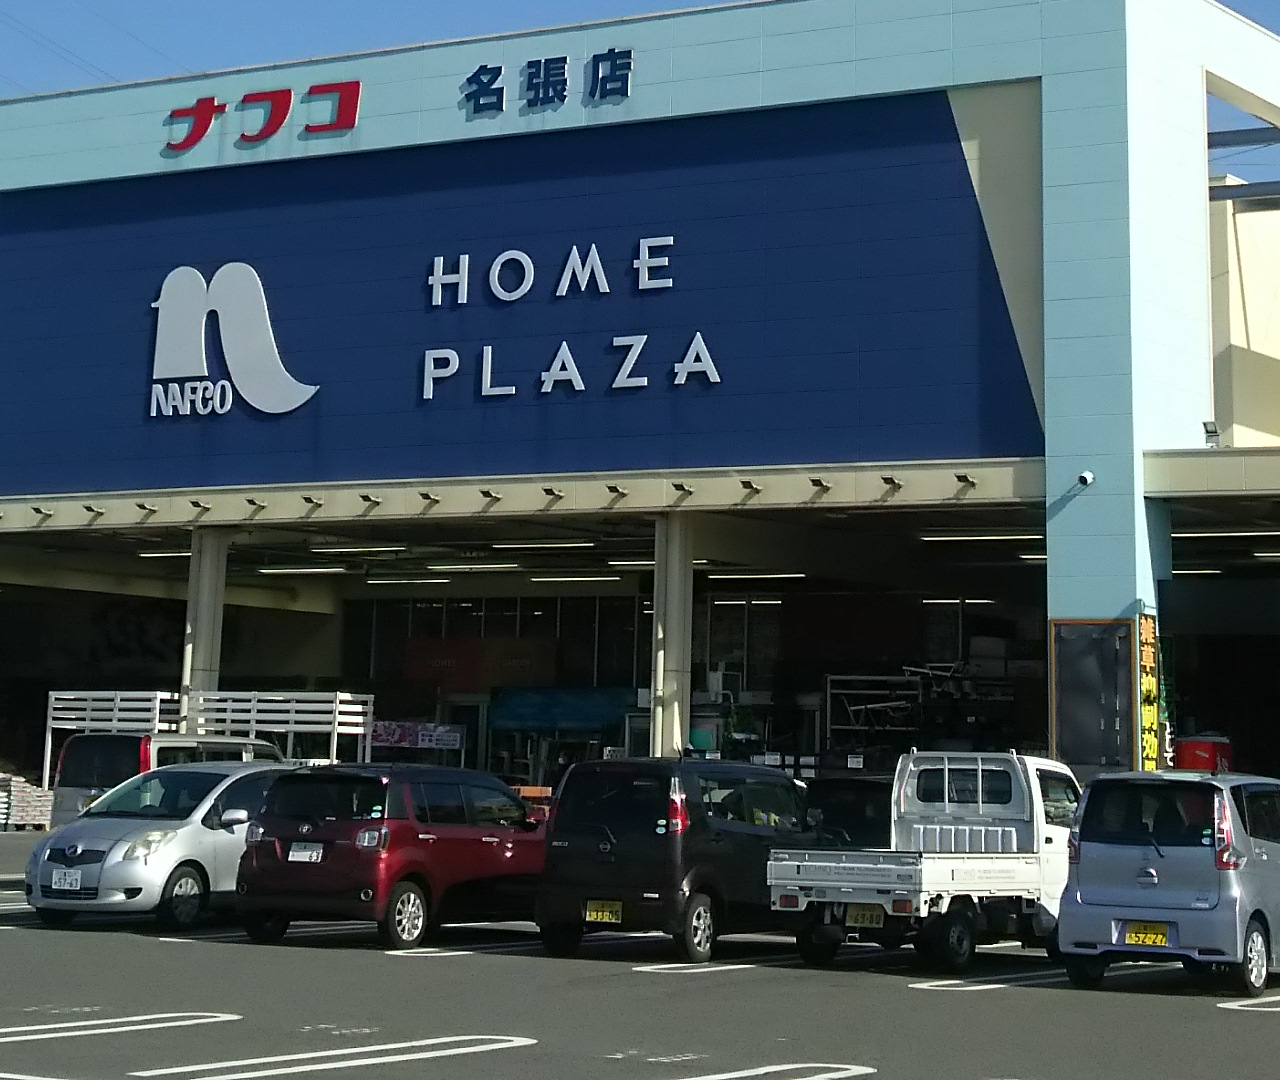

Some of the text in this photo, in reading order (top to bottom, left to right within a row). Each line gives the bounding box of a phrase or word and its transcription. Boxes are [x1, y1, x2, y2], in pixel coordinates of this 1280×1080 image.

[166, 48, 634, 152] ナフコ 名張店
[428, 236, 674, 306] HOME
[150, 380, 233, 417] NAFCO
[423, 331, 721, 400] PLAZA
